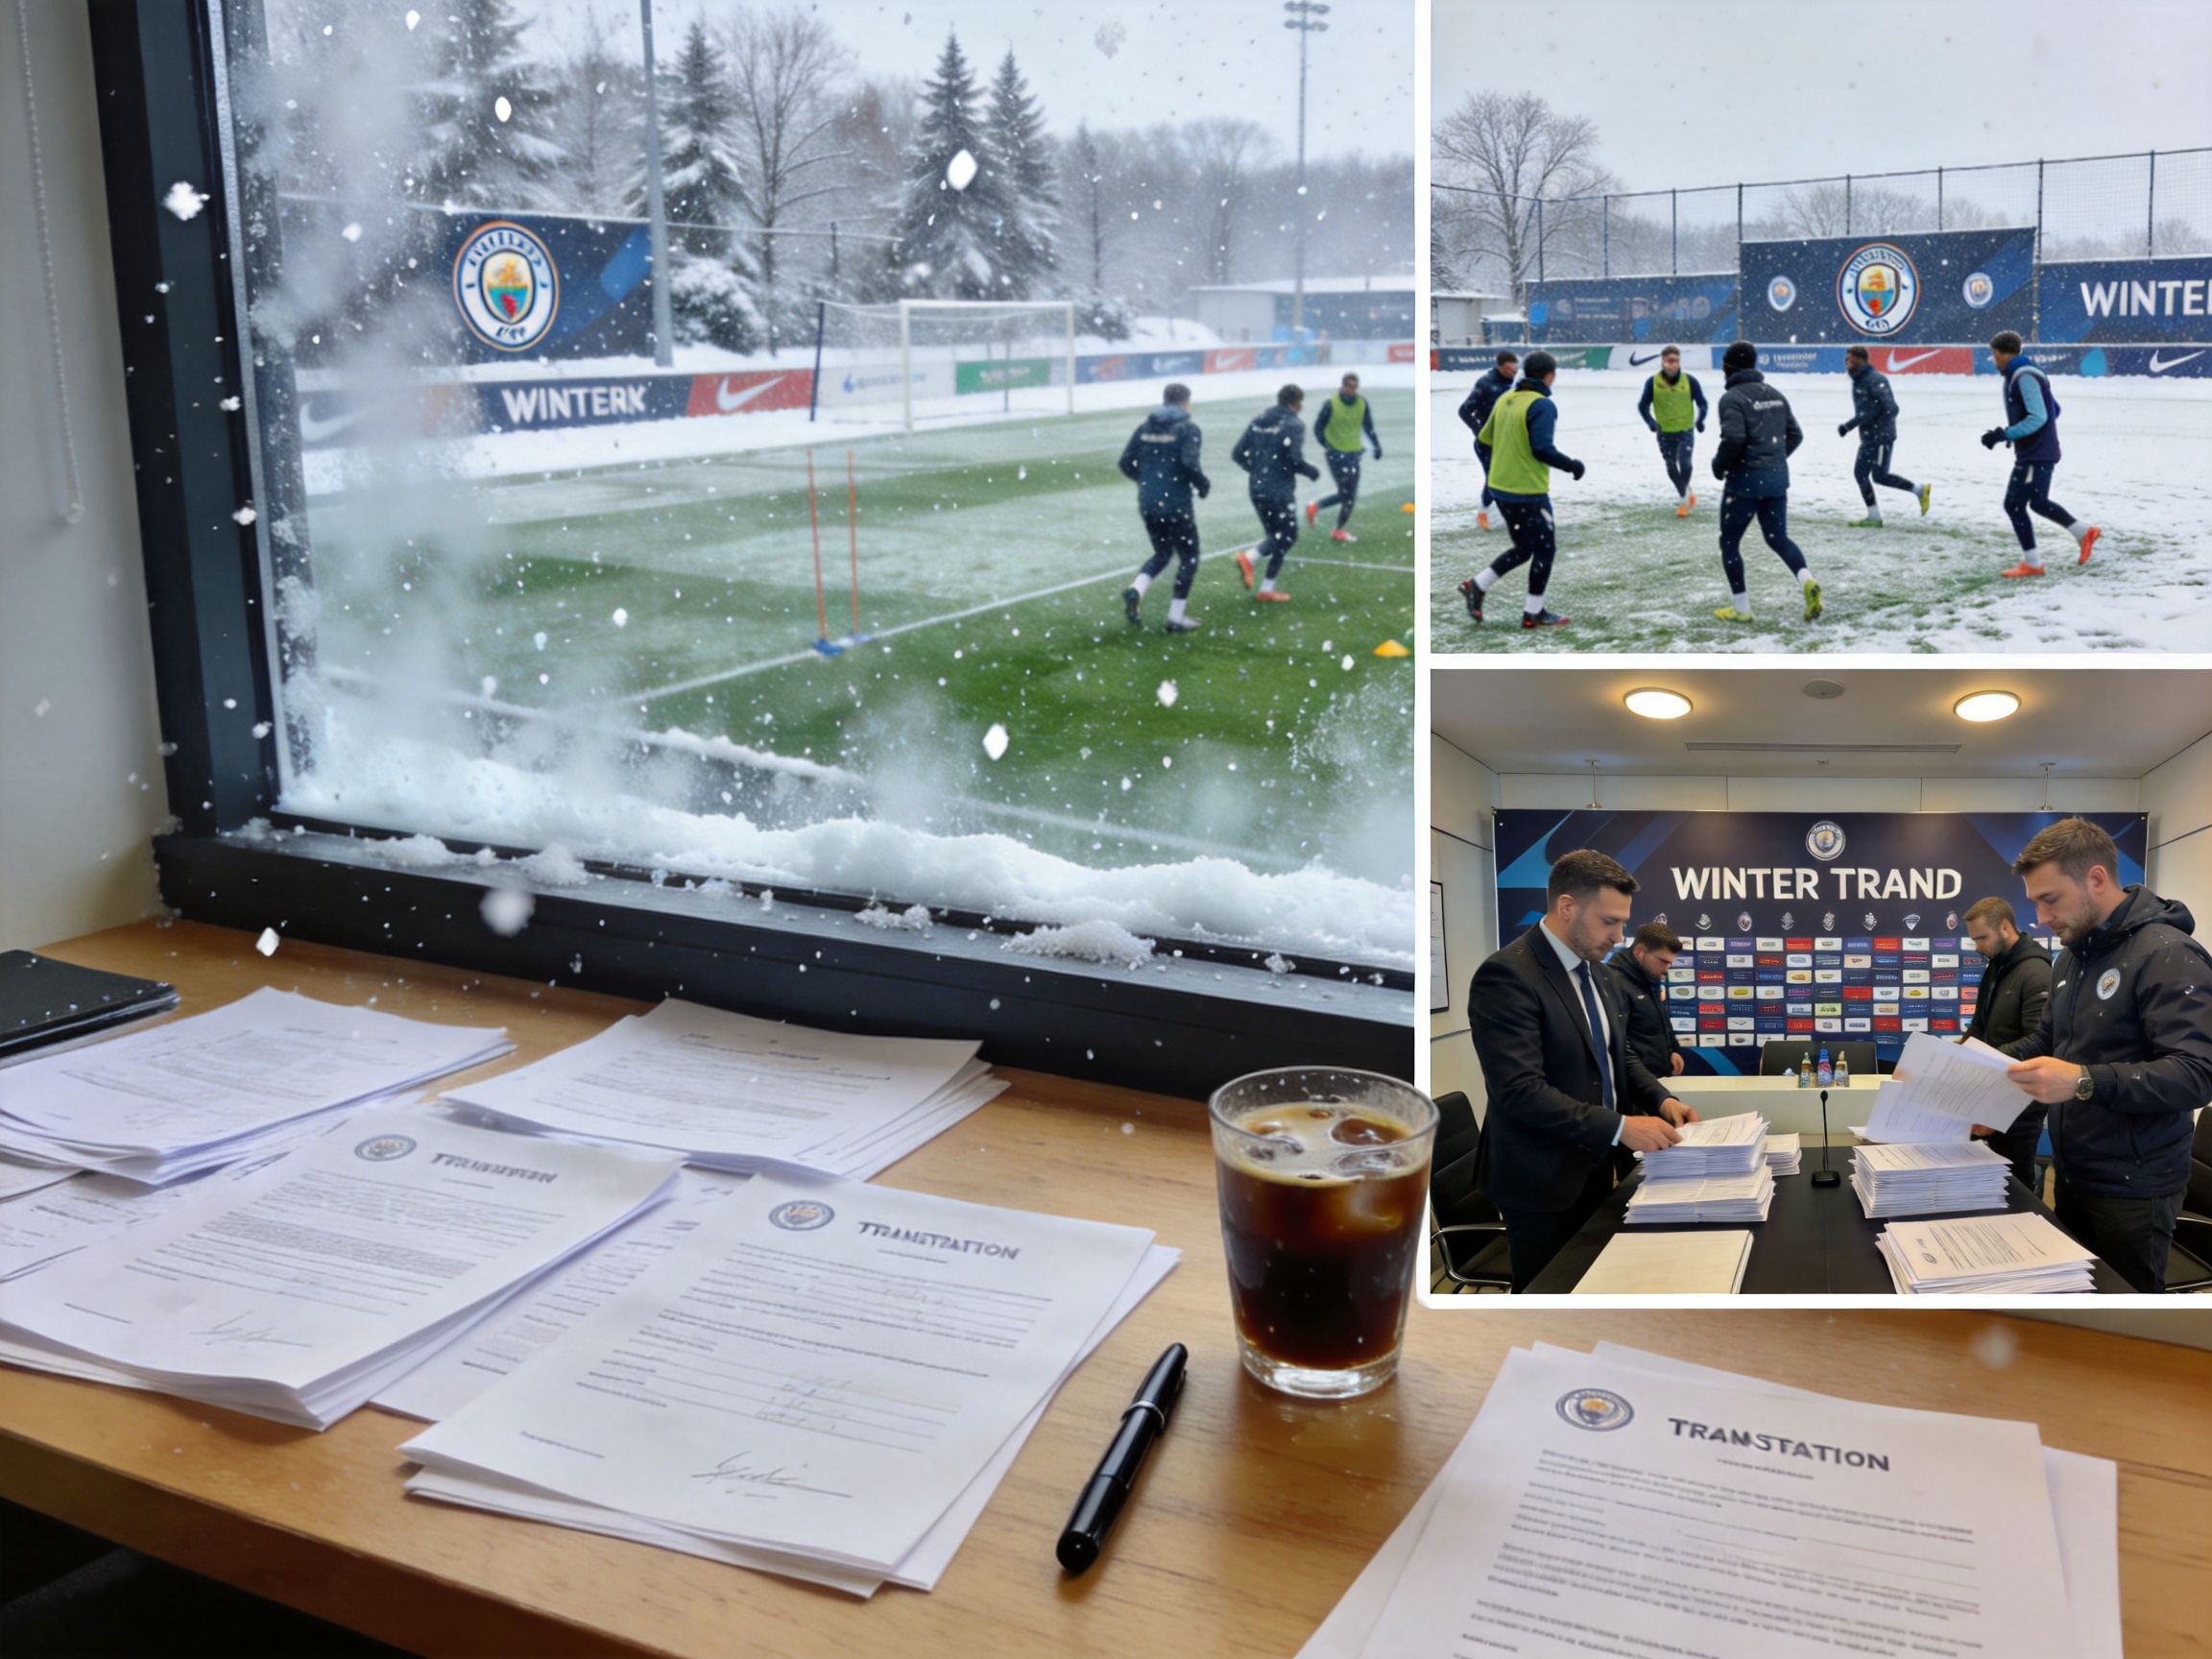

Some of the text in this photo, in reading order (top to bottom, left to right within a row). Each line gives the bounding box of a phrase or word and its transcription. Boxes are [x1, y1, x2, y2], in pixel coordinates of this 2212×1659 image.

[2080, 279, 2212, 317] WINTE
[1670, 867, 1962, 901] WINTER TRAND
[1668, 1417, 1890, 1472] TRANSTATION
